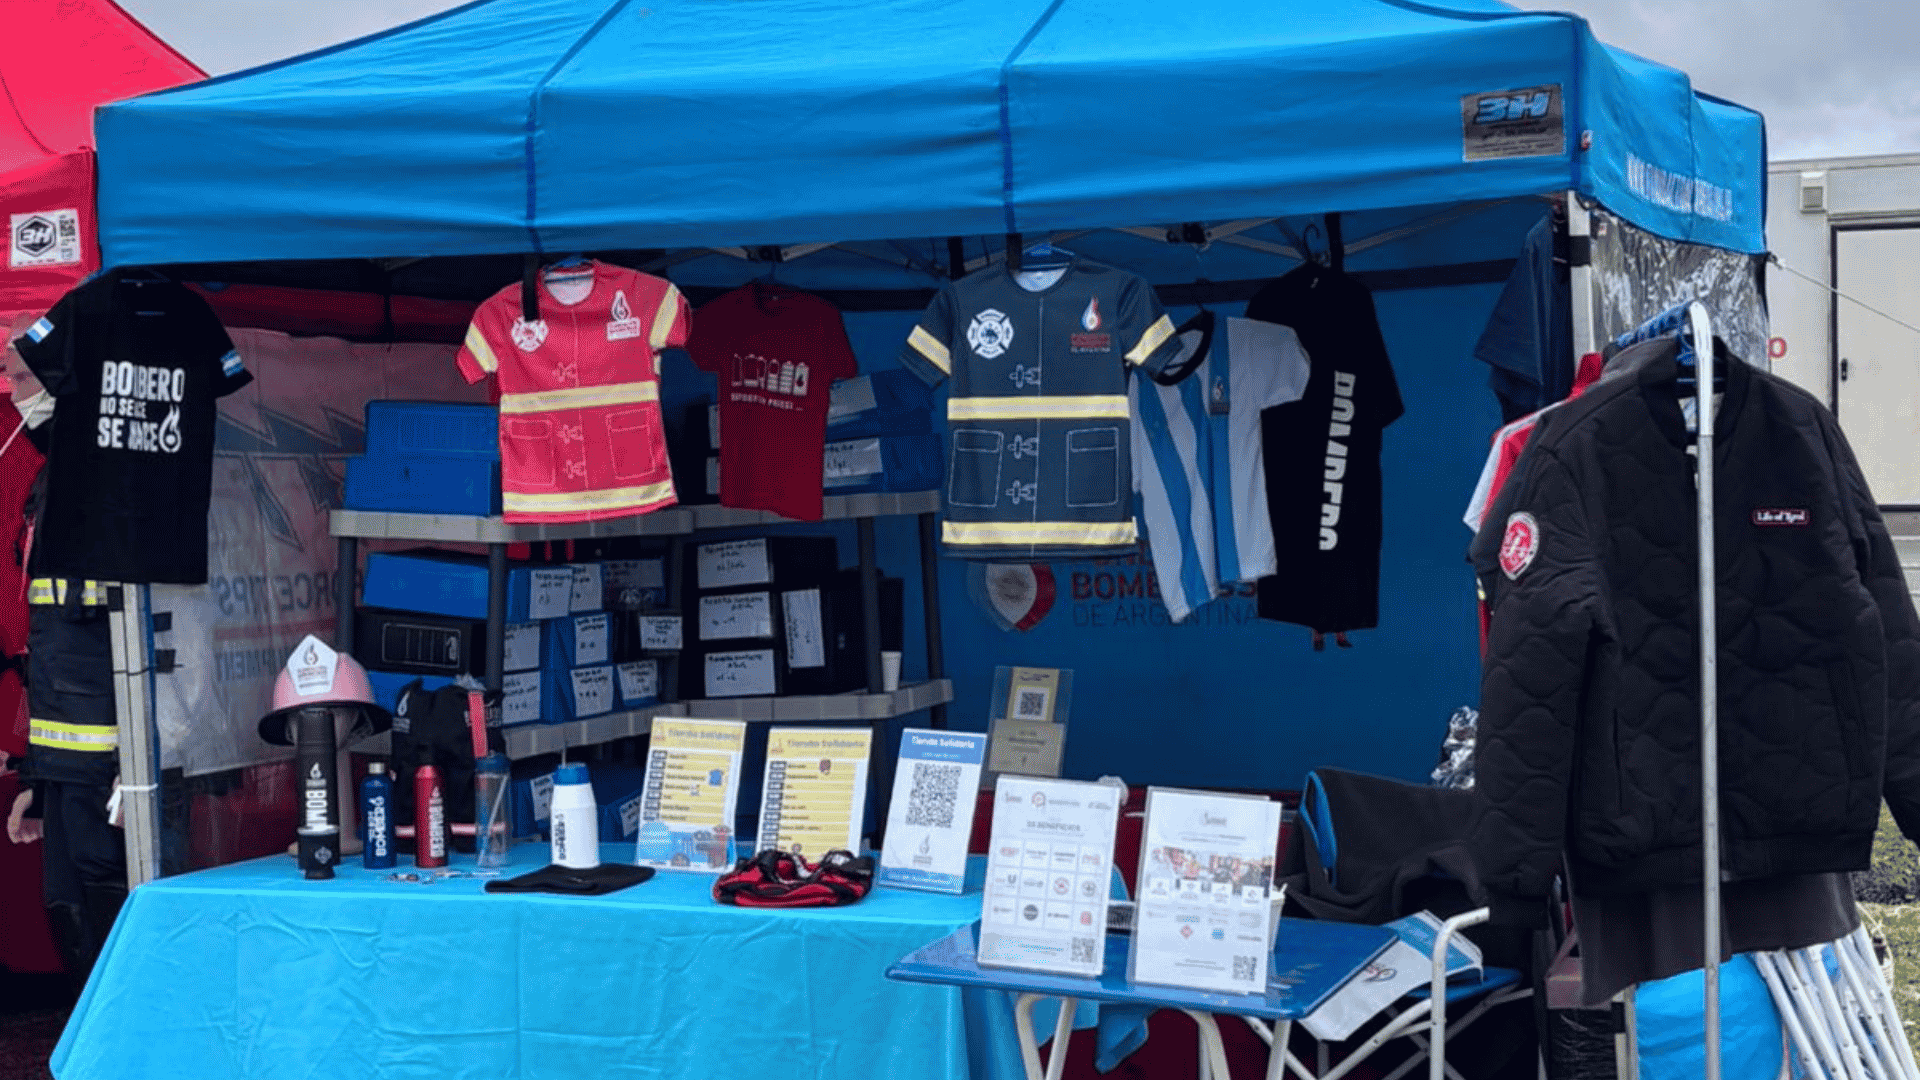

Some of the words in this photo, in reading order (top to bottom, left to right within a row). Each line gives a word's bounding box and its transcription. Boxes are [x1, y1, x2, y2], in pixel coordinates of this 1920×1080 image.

[1474, 91, 1552, 124] 3H
[118, 397, 135, 417] SE
[97, 416, 126, 448] SE
[1074, 604, 1103, 627] DE
